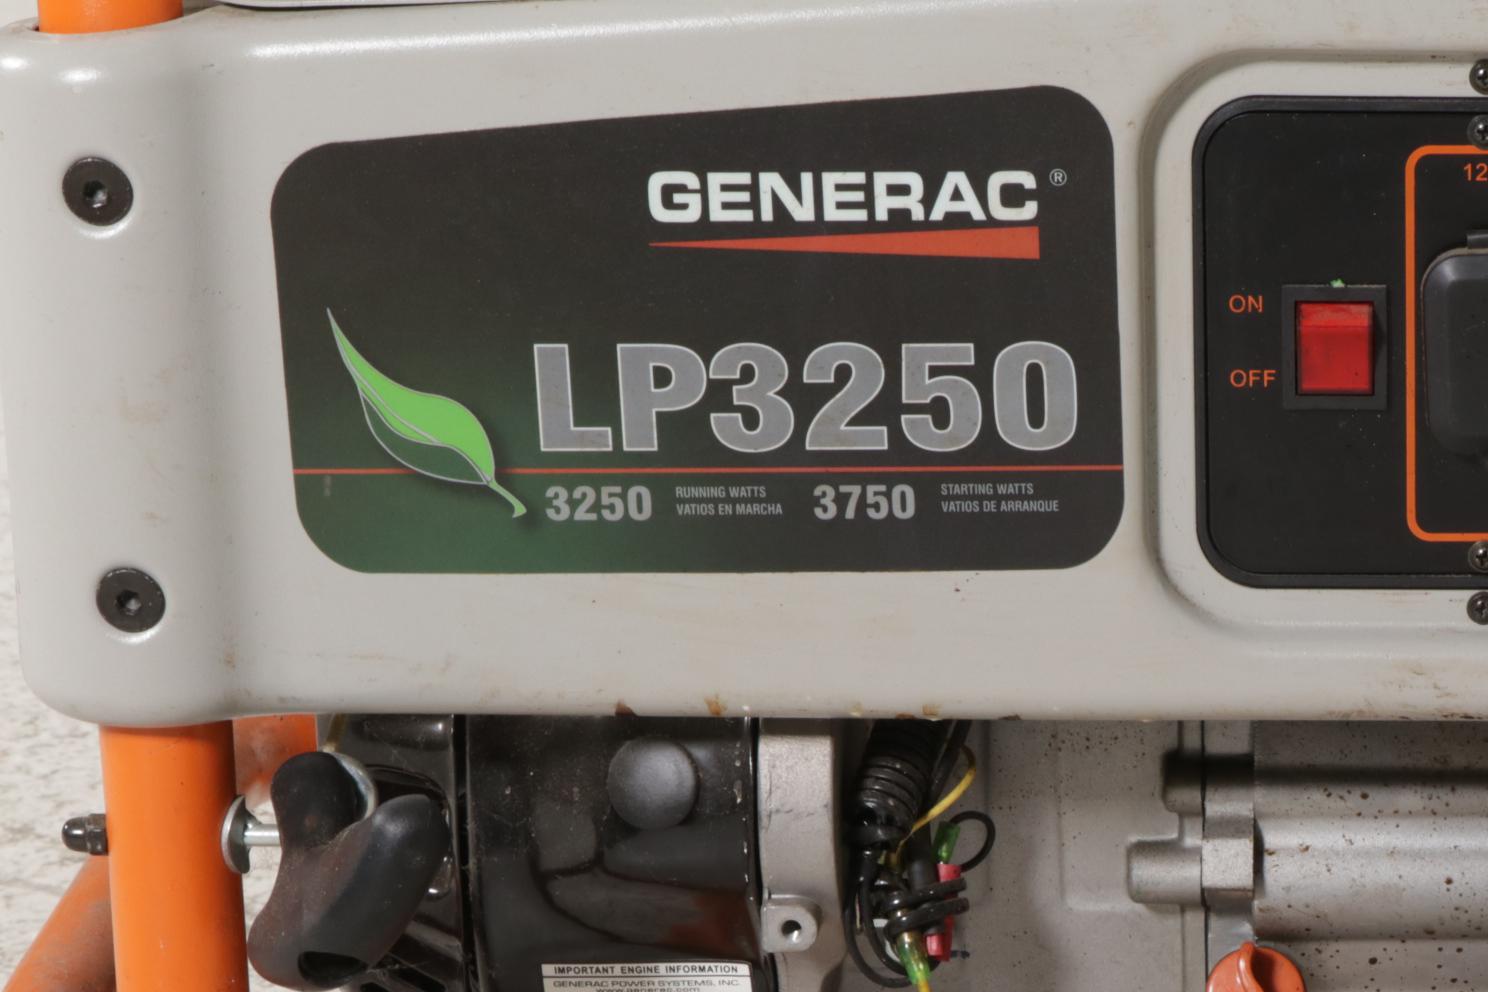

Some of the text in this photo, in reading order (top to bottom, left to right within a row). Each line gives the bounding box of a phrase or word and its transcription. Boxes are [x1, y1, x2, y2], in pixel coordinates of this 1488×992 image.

[647, 170, 1039, 223] GENERAC
[1228, 295, 1264, 313] ON
[1229, 369, 1276, 388] OFF
[533, 341, 1078, 453] LP3250
[675, 486, 766, 498] RUNNING WATTS
[941, 483, 1034, 495] STARTING WATTS
[545, 485, 652, 521] 3250
[676, 503, 783, 516] VATIOS EN MARCHA
[813, 484, 916, 520] 3750
[941, 500, 1059, 513] VATIOS DE ARRANQUE
[554, 965, 738, 975] IMPORTANT ENGINE INFORMATION
